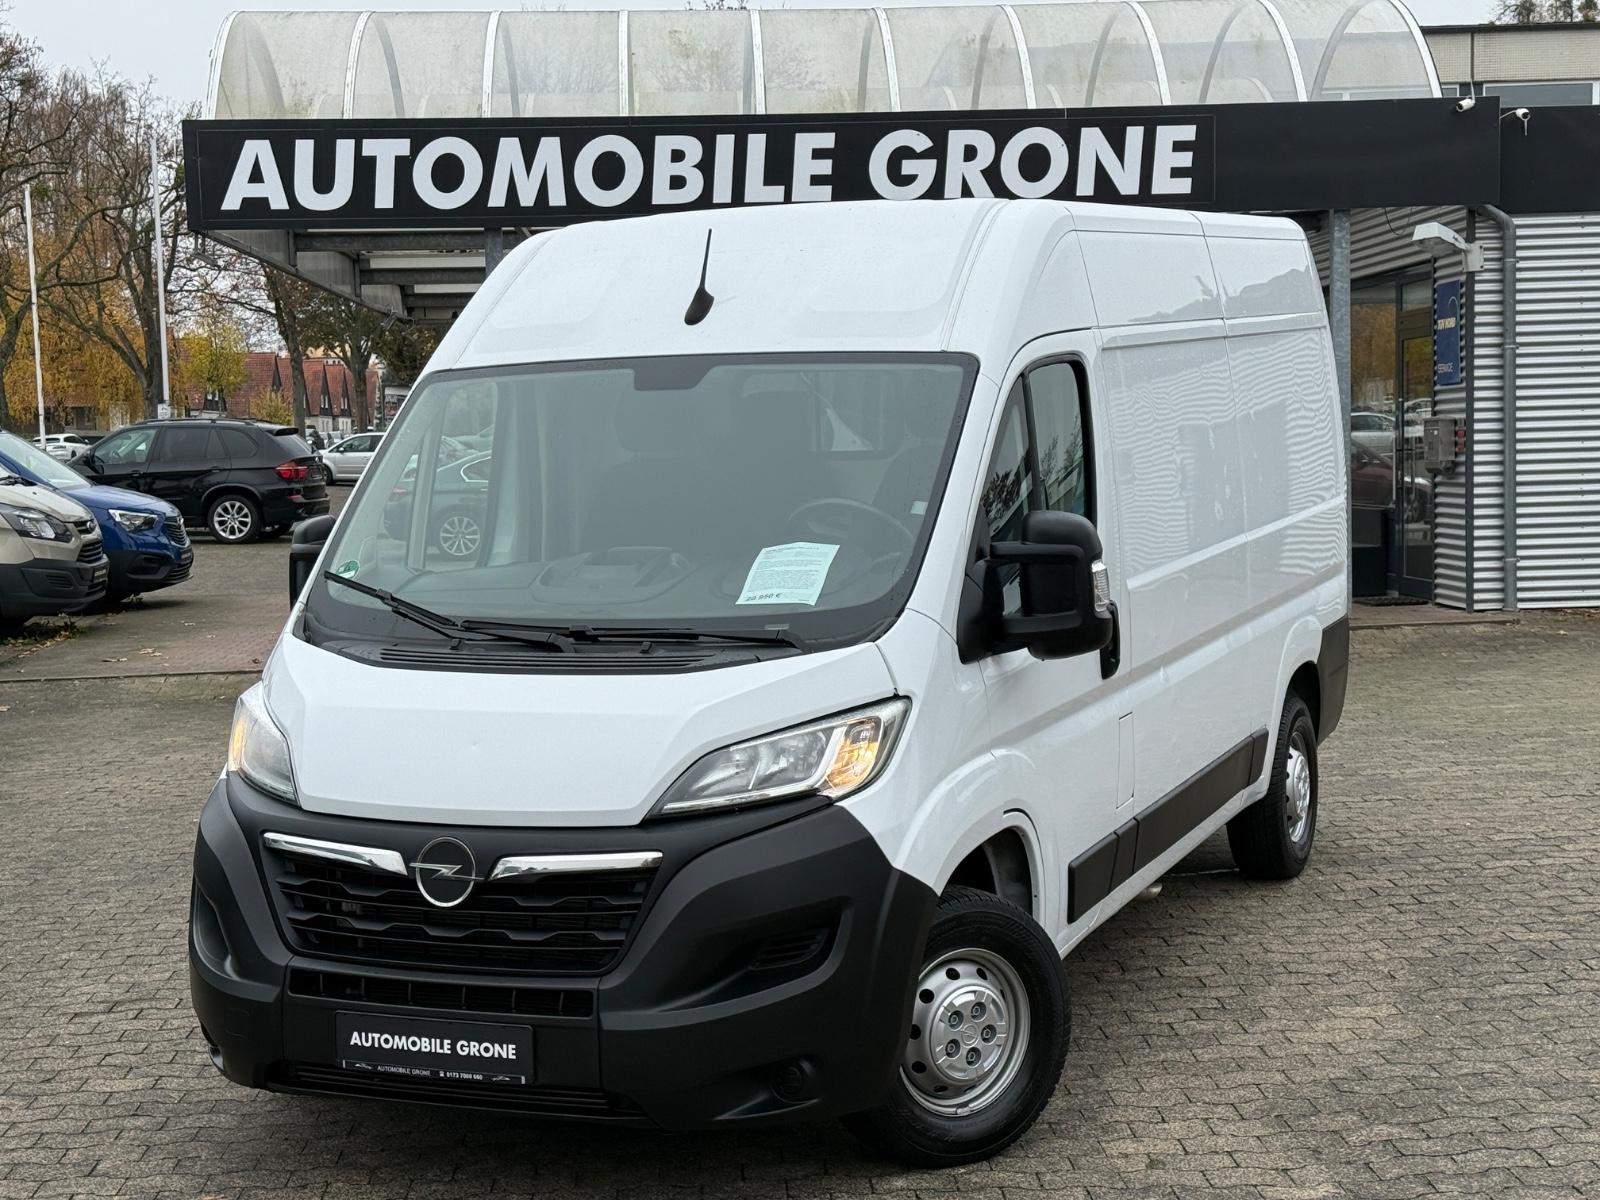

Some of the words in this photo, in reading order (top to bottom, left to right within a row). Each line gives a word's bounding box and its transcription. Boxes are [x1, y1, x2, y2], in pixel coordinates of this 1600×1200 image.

[220, 131, 836, 211] AUTOMOBILE
[868, 124, 1197, 201] GRONE
[349, 1031, 452, 1054] AUTOMOBILE
[456, 1040, 517, 1060] GRONE
[377, 1065, 411, 1075] AUTOMOBILE
[411, 1068, 431, 1076] GRONE
